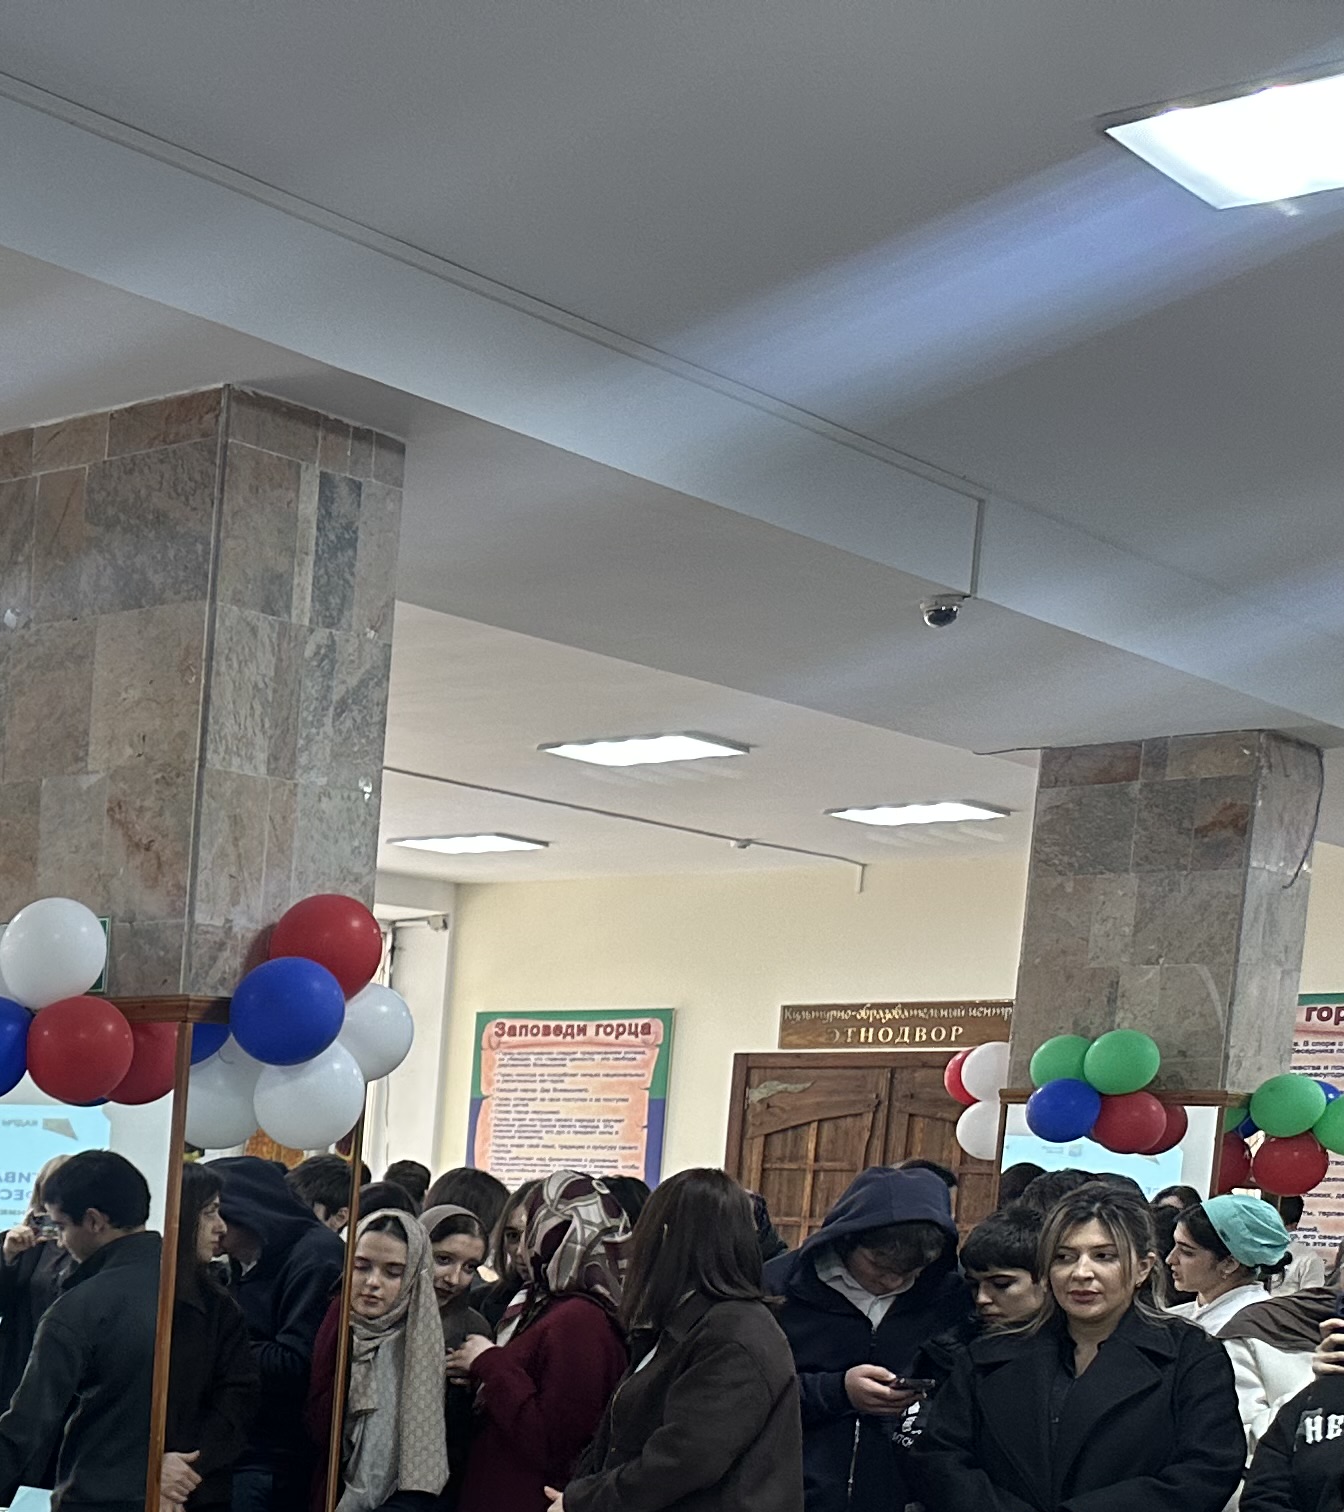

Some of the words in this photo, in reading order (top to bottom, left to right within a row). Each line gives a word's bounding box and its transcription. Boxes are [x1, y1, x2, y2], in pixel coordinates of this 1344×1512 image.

[494, 1021, 587, 1040] Заповеди
[595, 1023, 652, 1040] горца
[827, 1025, 964, 1044] ЭТНОДВОР
